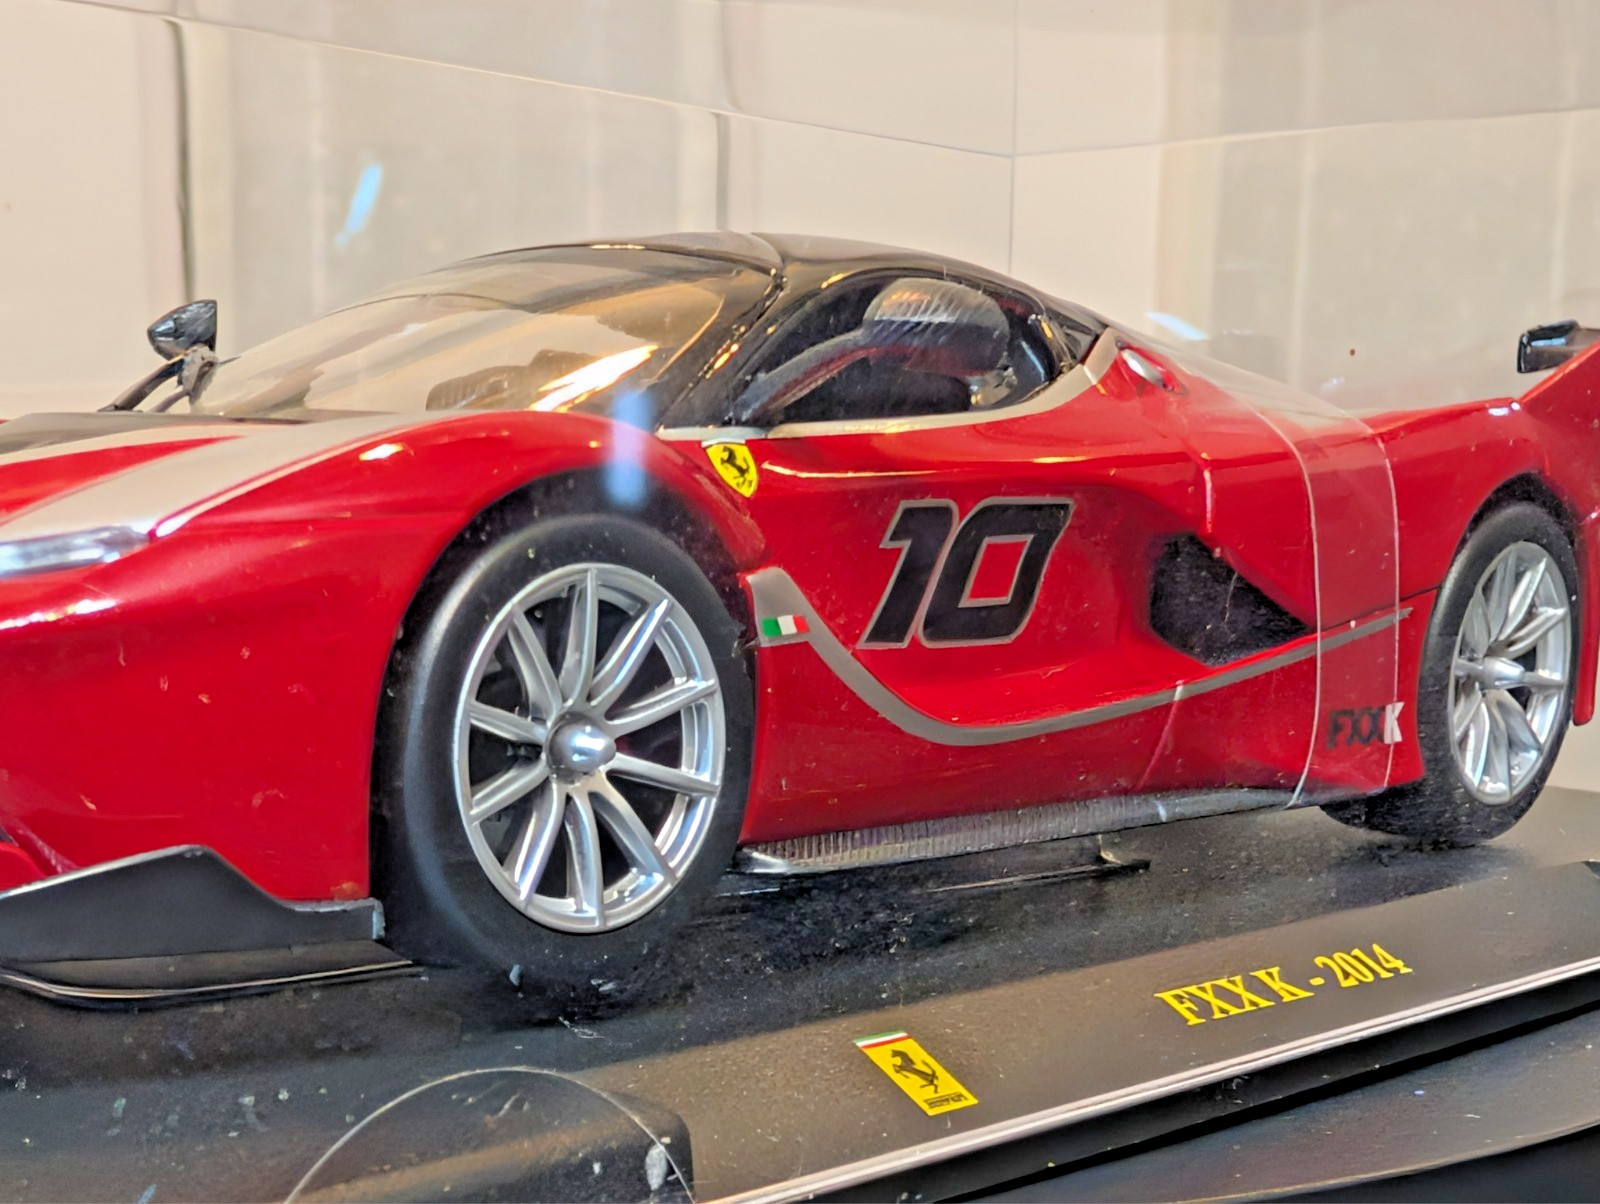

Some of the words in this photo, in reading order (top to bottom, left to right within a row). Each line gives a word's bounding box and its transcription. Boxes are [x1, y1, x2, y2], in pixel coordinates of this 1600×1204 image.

[856, 496, 1077, 649] 10
[1154, 975, 1275, 1026] FXX
[1250, 966, 1314, 1002] K
[1314, 943, 1413, 988] 2014
